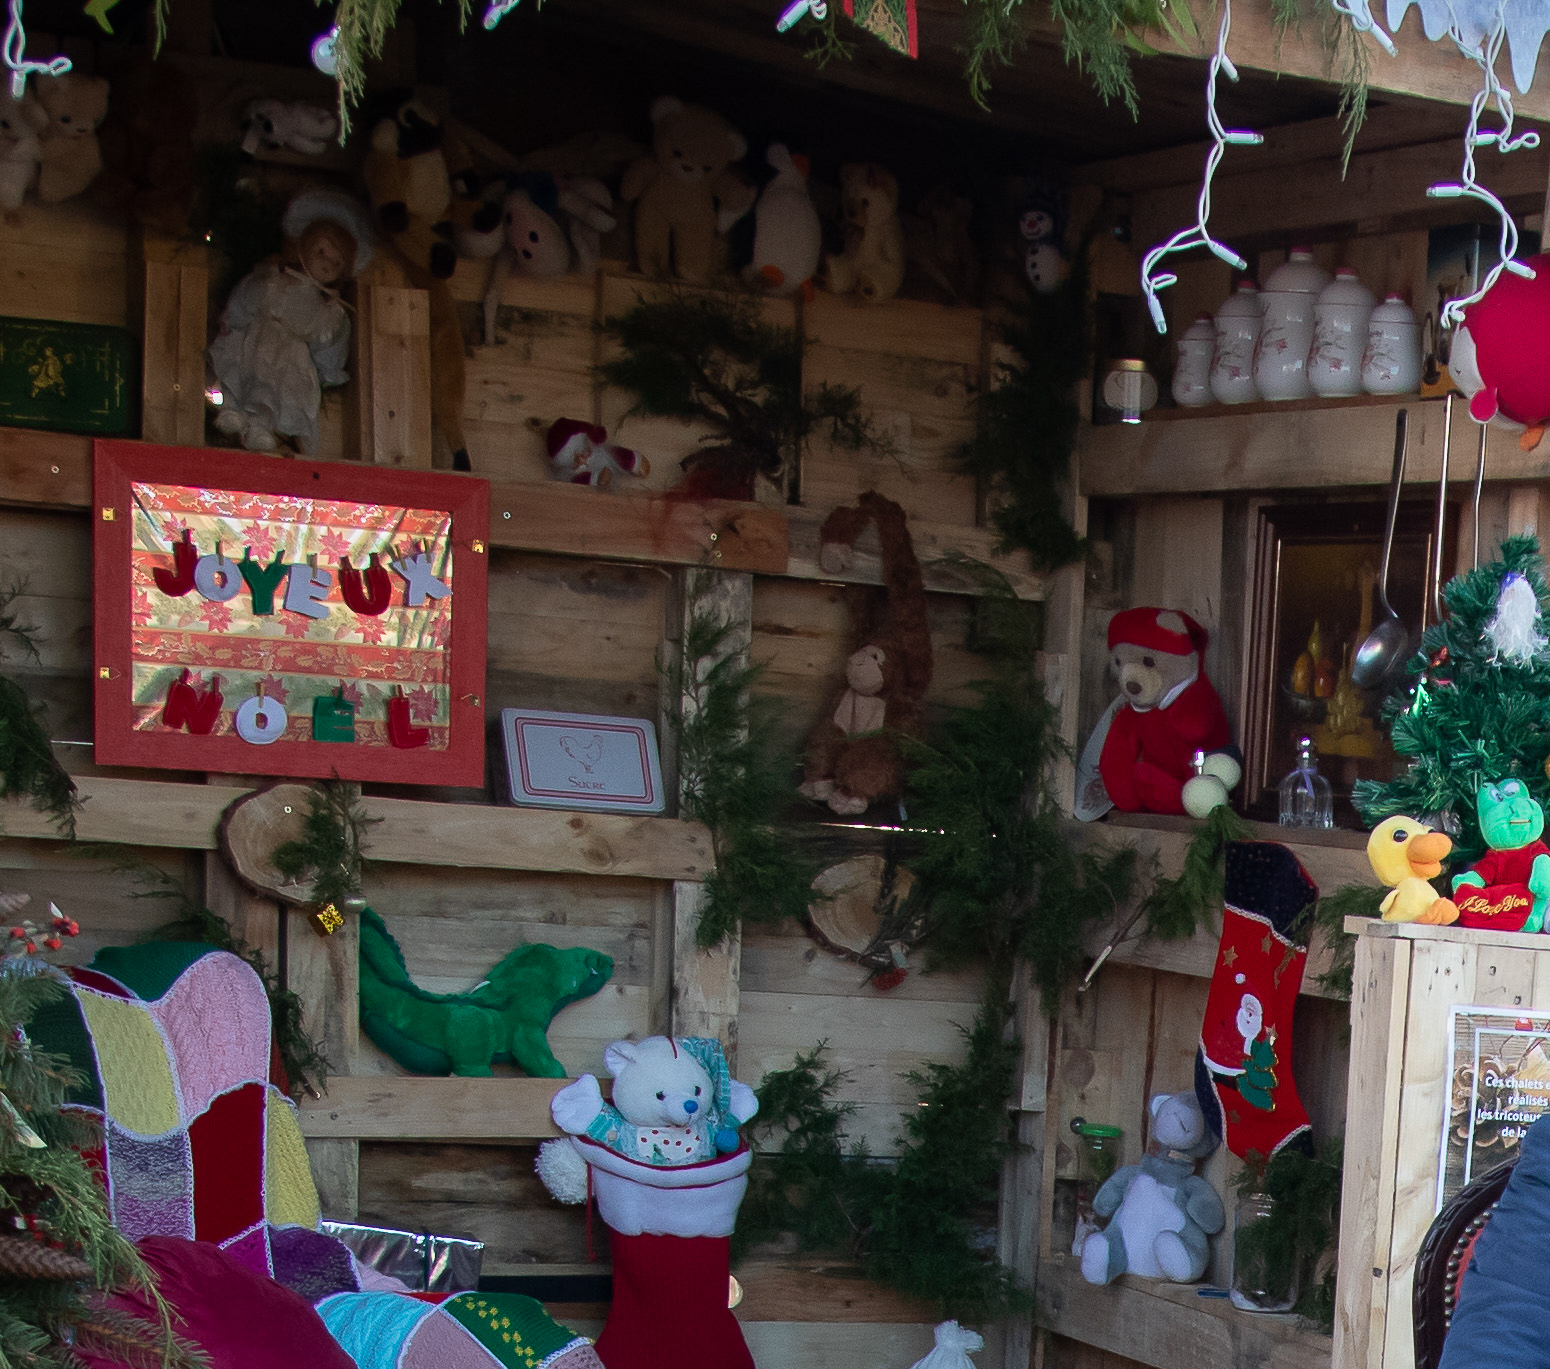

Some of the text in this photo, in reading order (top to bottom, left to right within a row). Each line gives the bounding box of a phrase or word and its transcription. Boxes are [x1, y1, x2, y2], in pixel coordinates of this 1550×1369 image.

[153, 540, 453, 619] JOYEUX
[162, 676, 430, 749] NOEL
[1485, 1076, 1504, 1088] Ces
[1505, 1076, 1543, 1090] chalets
[1477, 1108, 1495, 1121] les
[1495, 1110, 1542, 1123] tricoteu
[1502, 1126, 1515, 1137] de
